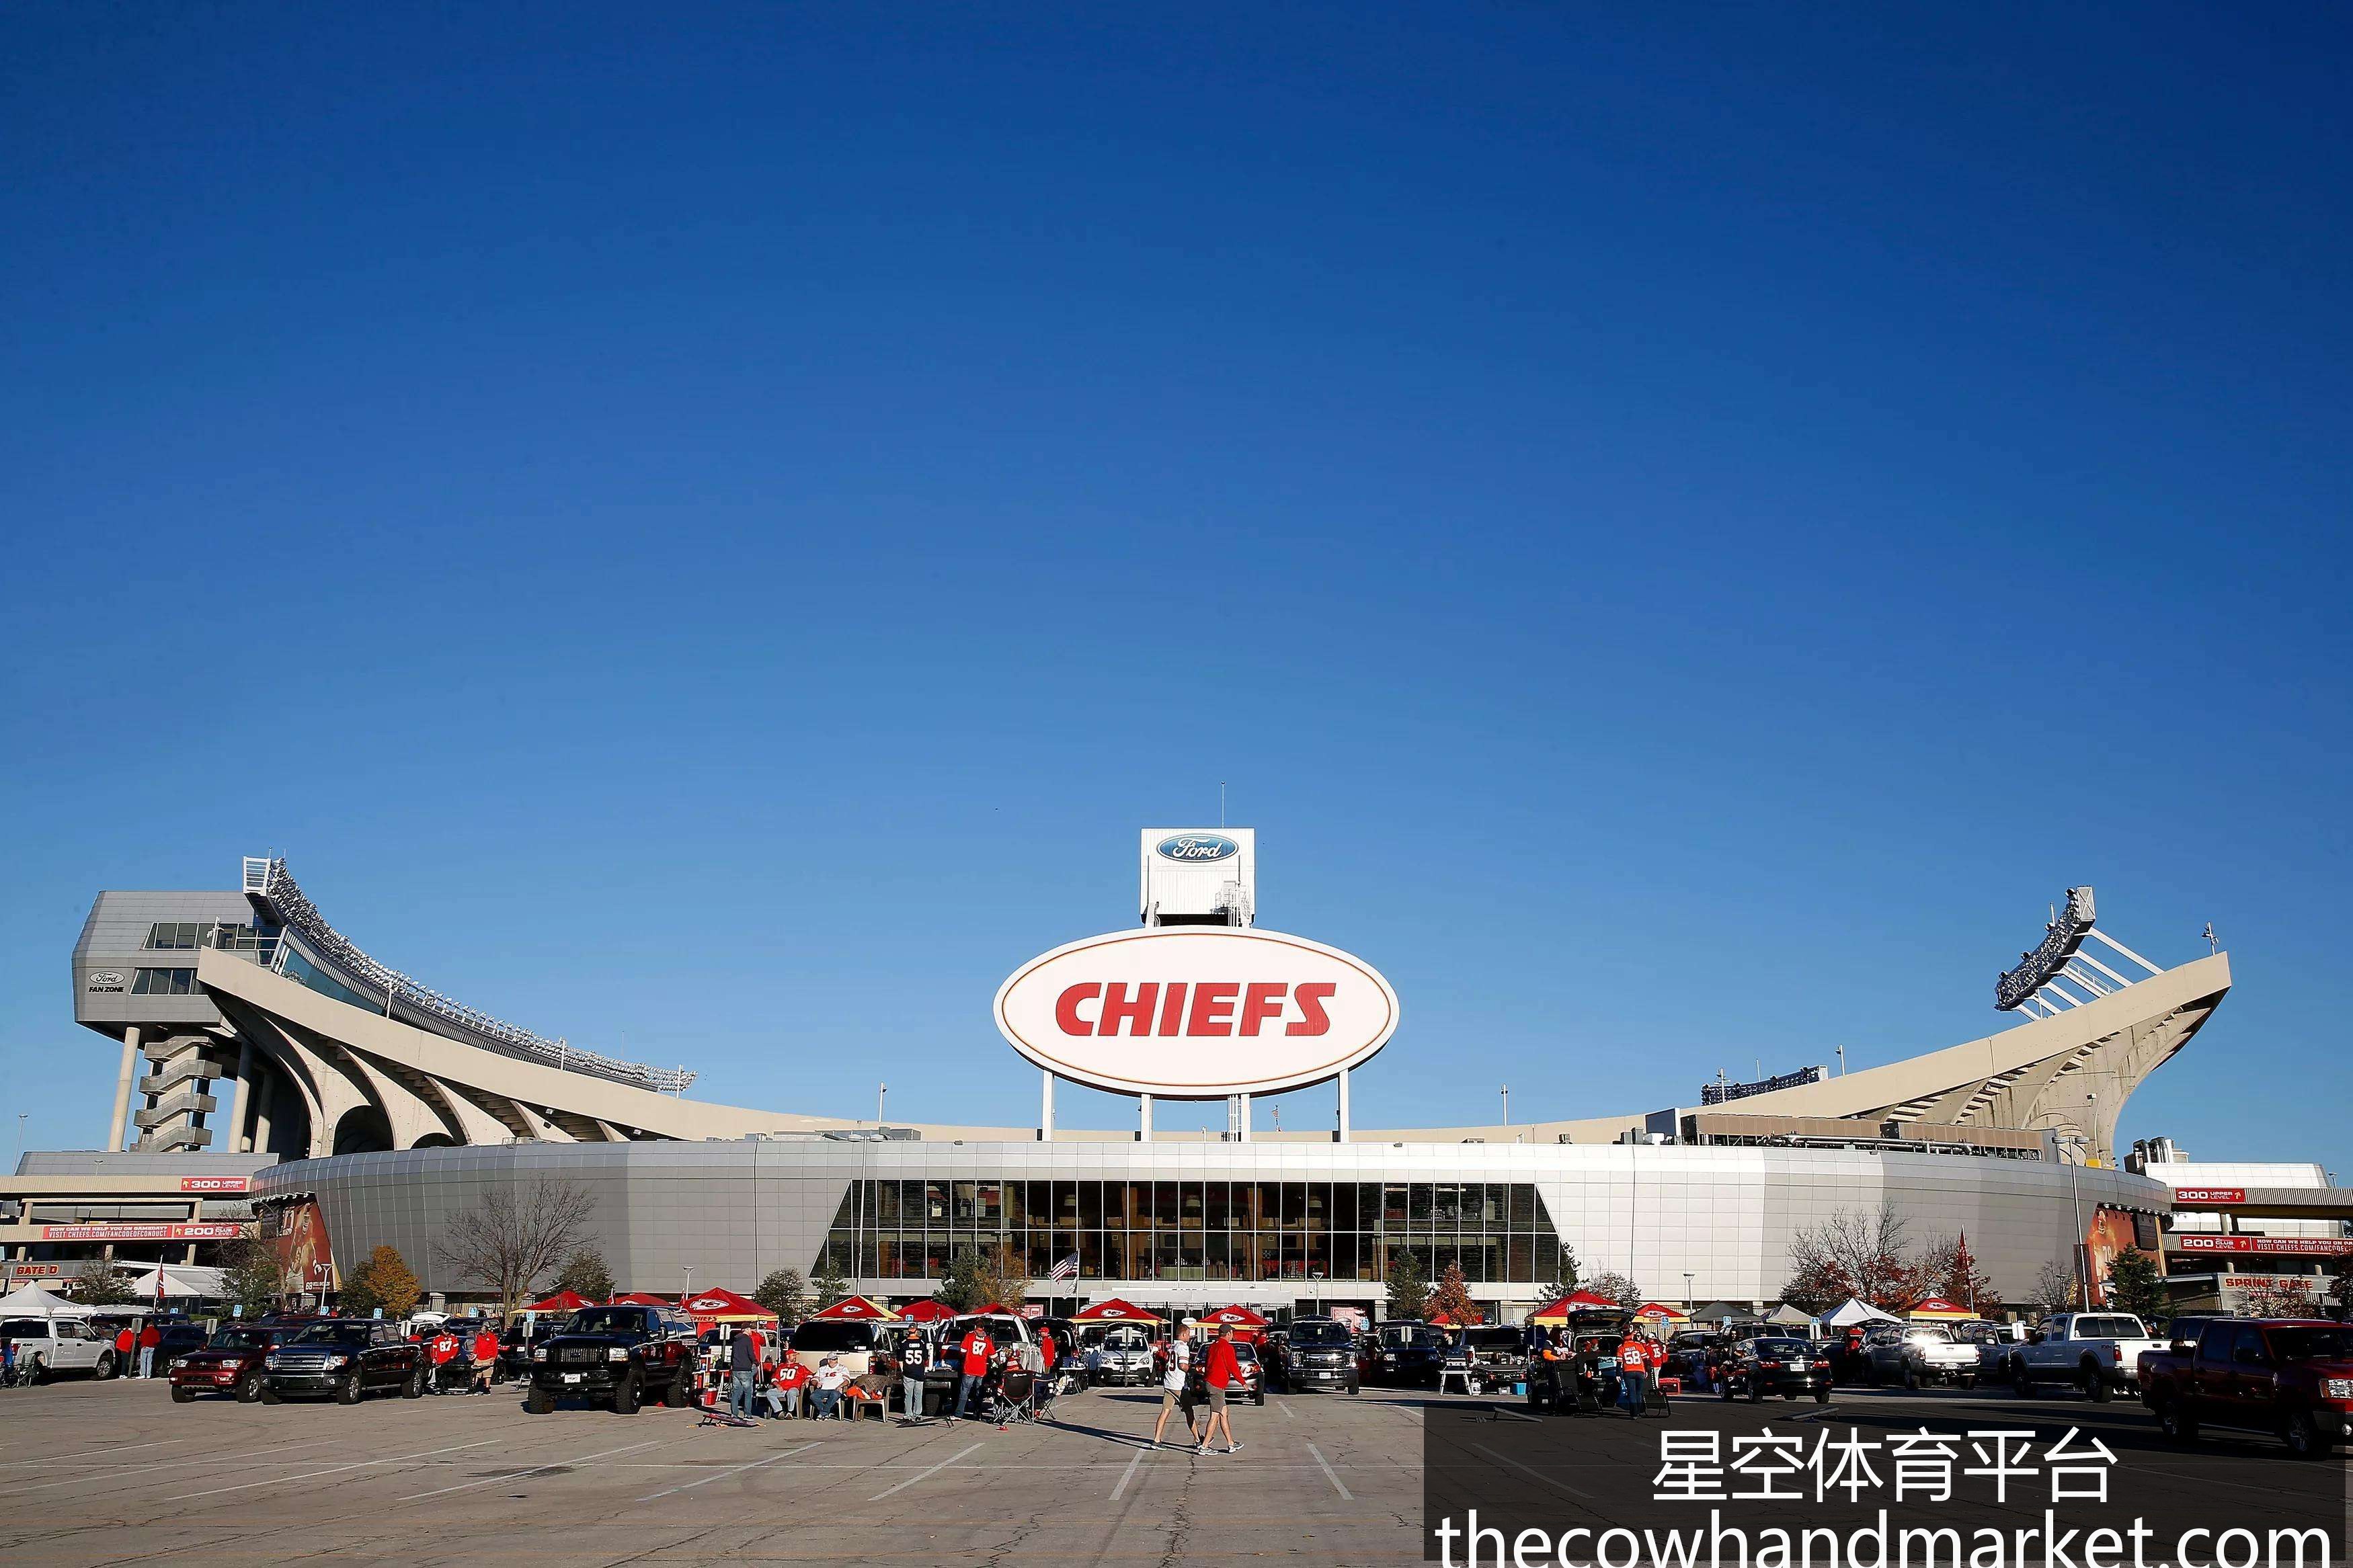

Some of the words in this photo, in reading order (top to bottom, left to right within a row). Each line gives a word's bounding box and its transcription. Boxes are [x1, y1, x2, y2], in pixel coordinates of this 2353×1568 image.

[1172, 838, 1223, 858] Ford
[95, 973, 118, 982] Ford
[1056, 983, 1336, 1036] CHIEFS
[191, 1180, 221, 1188] 300
[2178, 1191, 2208, 1199] 300
[17, 1266, 46, 1276] GATE
[49, 1265, 58, 1275] D
[306, 1282, 313, 1290] 68
[2225, 1278, 2274, 1288] SPRINT
[440, 1341, 452, 1352] 87
[972, 1341, 986, 1356] 87
[905, 1350, 922, 1364] 55
[1624, 1351, 1641, 1364] 58
[1653, 1348, 1661, 1358] 15
[780, 1368, 797, 1380] 50
